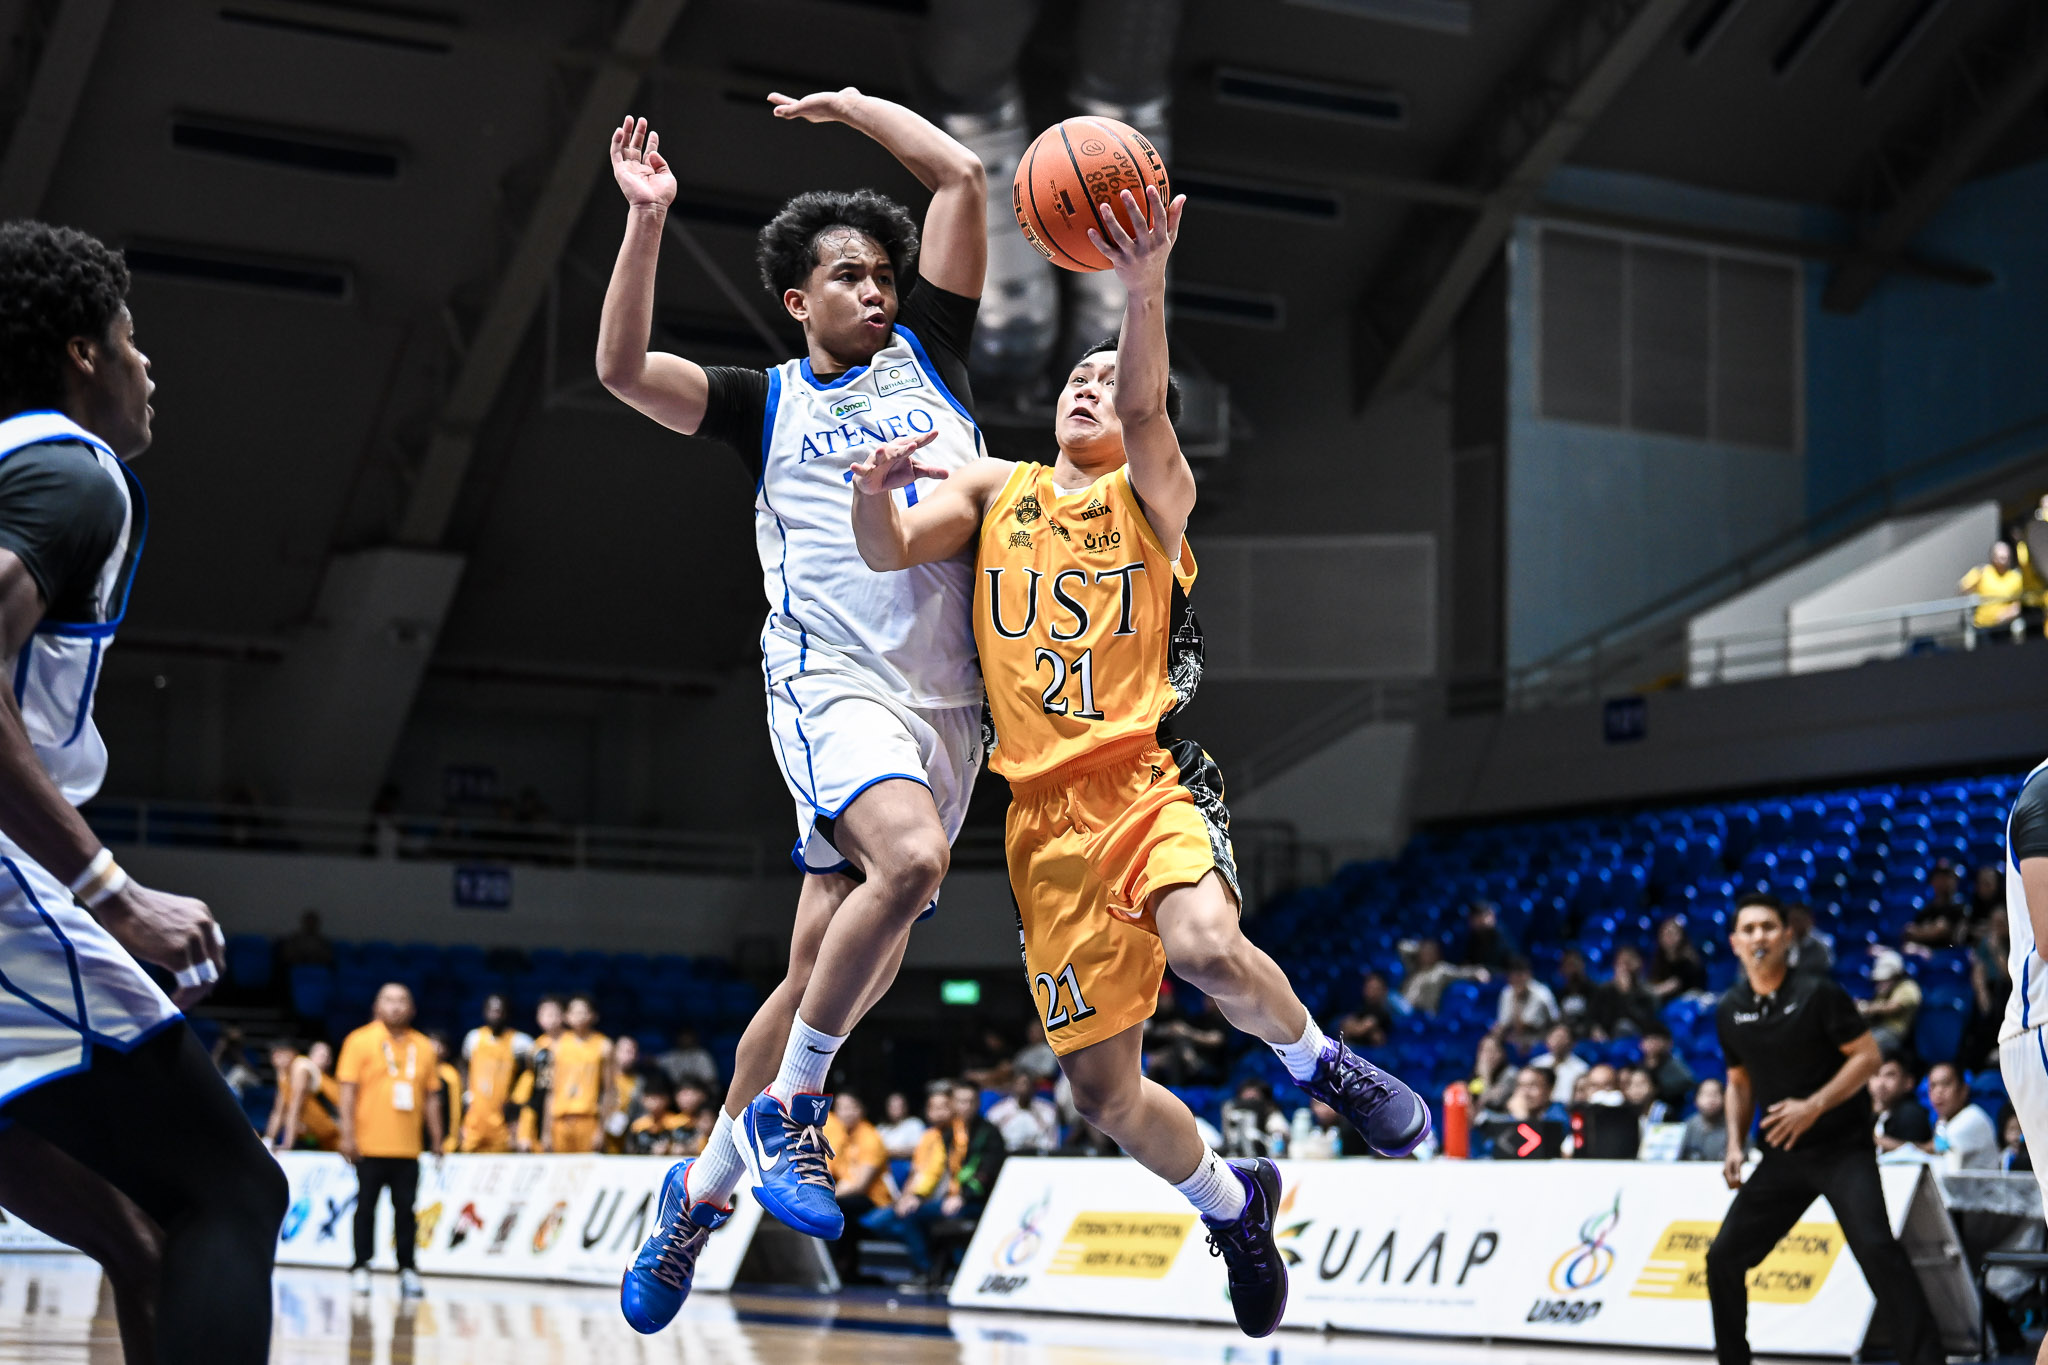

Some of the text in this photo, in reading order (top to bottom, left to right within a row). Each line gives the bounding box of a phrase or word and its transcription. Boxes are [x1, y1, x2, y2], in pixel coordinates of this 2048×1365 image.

[1113, 151, 1141, 189] UAAP
[843, 400, 868, 413] Smart
[881, 377, 918, 391] ARTHALAND
[798, 408, 934, 465] ATENEO
[1081, 505, 1112, 521] DELTA
[985, 561, 1147, 642] UST
[1035, 646, 1105, 721] 21
[1035, 962, 1097, 1032] 21
[1319, 1228, 1499, 1286] UAAP
[1525, 1299, 1603, 1324] UAAP
